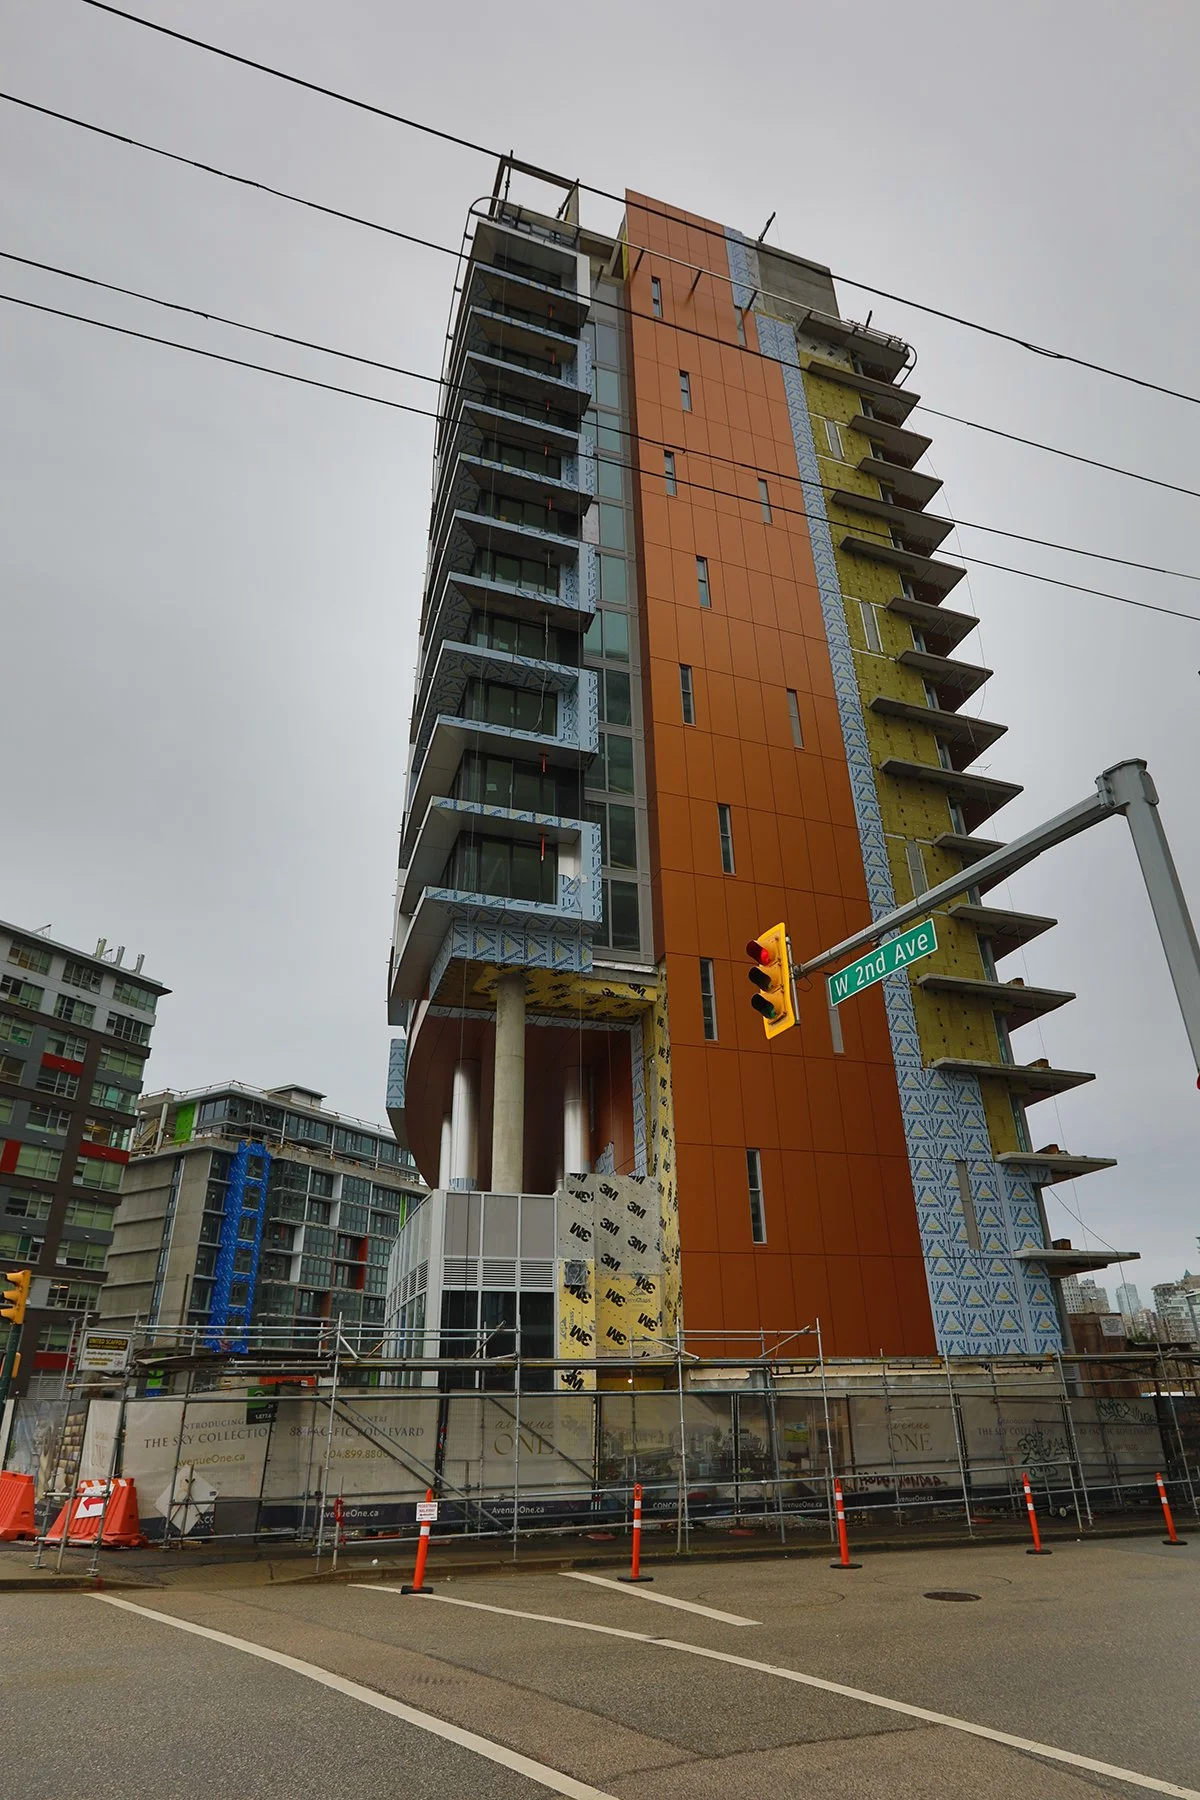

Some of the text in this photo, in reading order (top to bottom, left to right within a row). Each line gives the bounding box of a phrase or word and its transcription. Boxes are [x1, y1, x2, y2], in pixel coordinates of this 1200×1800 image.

[835, 932, 928, 997] W 2nd Ave
[599, 1183, 619, 1201] 3M
[627, 1201, 647, 1219] 3M
[600, 1218, 620, 1236] 3M
[628, 1236, 648, 1254] 3M
[600, 1253, 621, 1271] 3M
[181, 1418, 244, 1430] NTRODUCING
[307, 1427, 354, 1437] PACFIC
[356, 1427, 424, 1437] BOUEVARD
[495, 1420, 554, 1431] avnue
[144, 1437, 168, 1448] THE
[173, 1434, 196, 1447] SKY
[494, 1433, 554, 1455] ONE
[888, 1432, 933, 1452] ONE
[321, 1509, 379, 1519] AveueOne.ca
[491, 1505, 545, 1514] AvenuOne.ca
[780, 1501, 823, 1509] venueOne.ca
